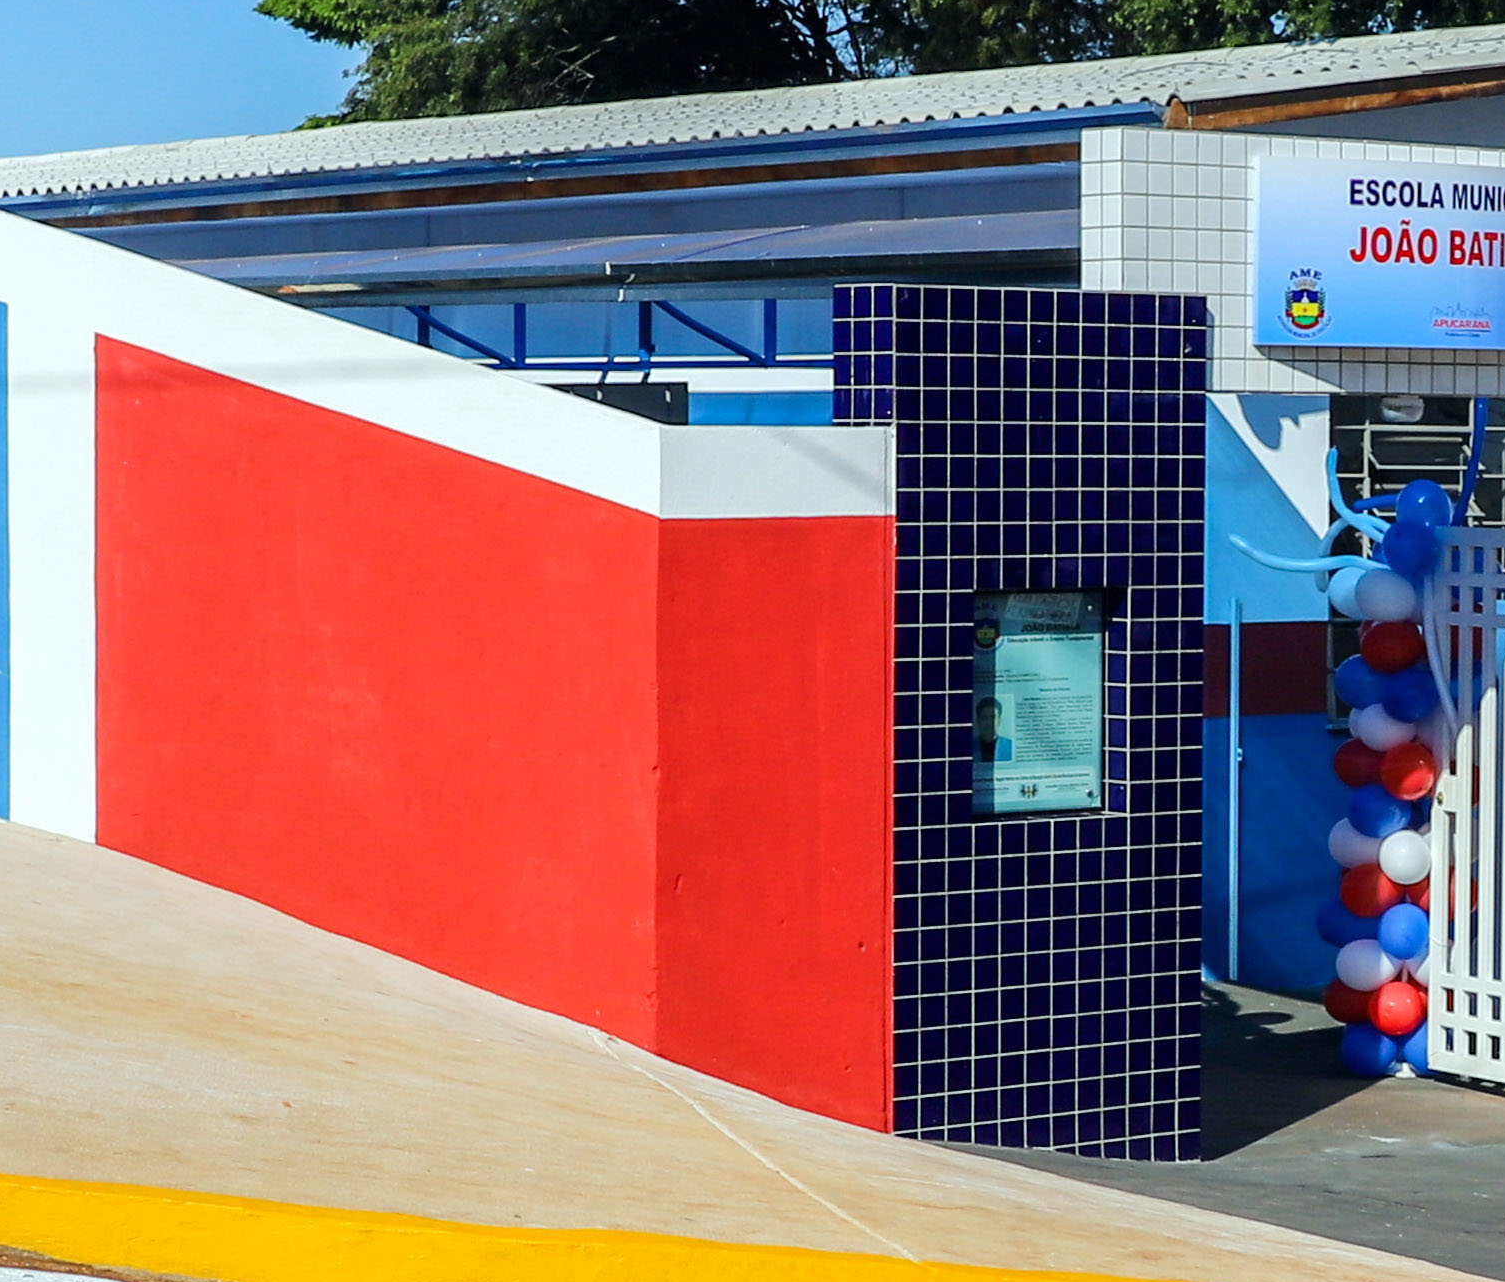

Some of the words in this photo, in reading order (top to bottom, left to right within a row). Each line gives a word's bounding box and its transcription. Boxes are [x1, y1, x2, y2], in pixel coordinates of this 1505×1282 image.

[1350, 179, 1444, 208] ESCOLA
[1350, 219, 1438, 264] JOÃO
[1290, 268, 1323, 280] AME
[1433, 319, 1491, 329] APUCARANA
